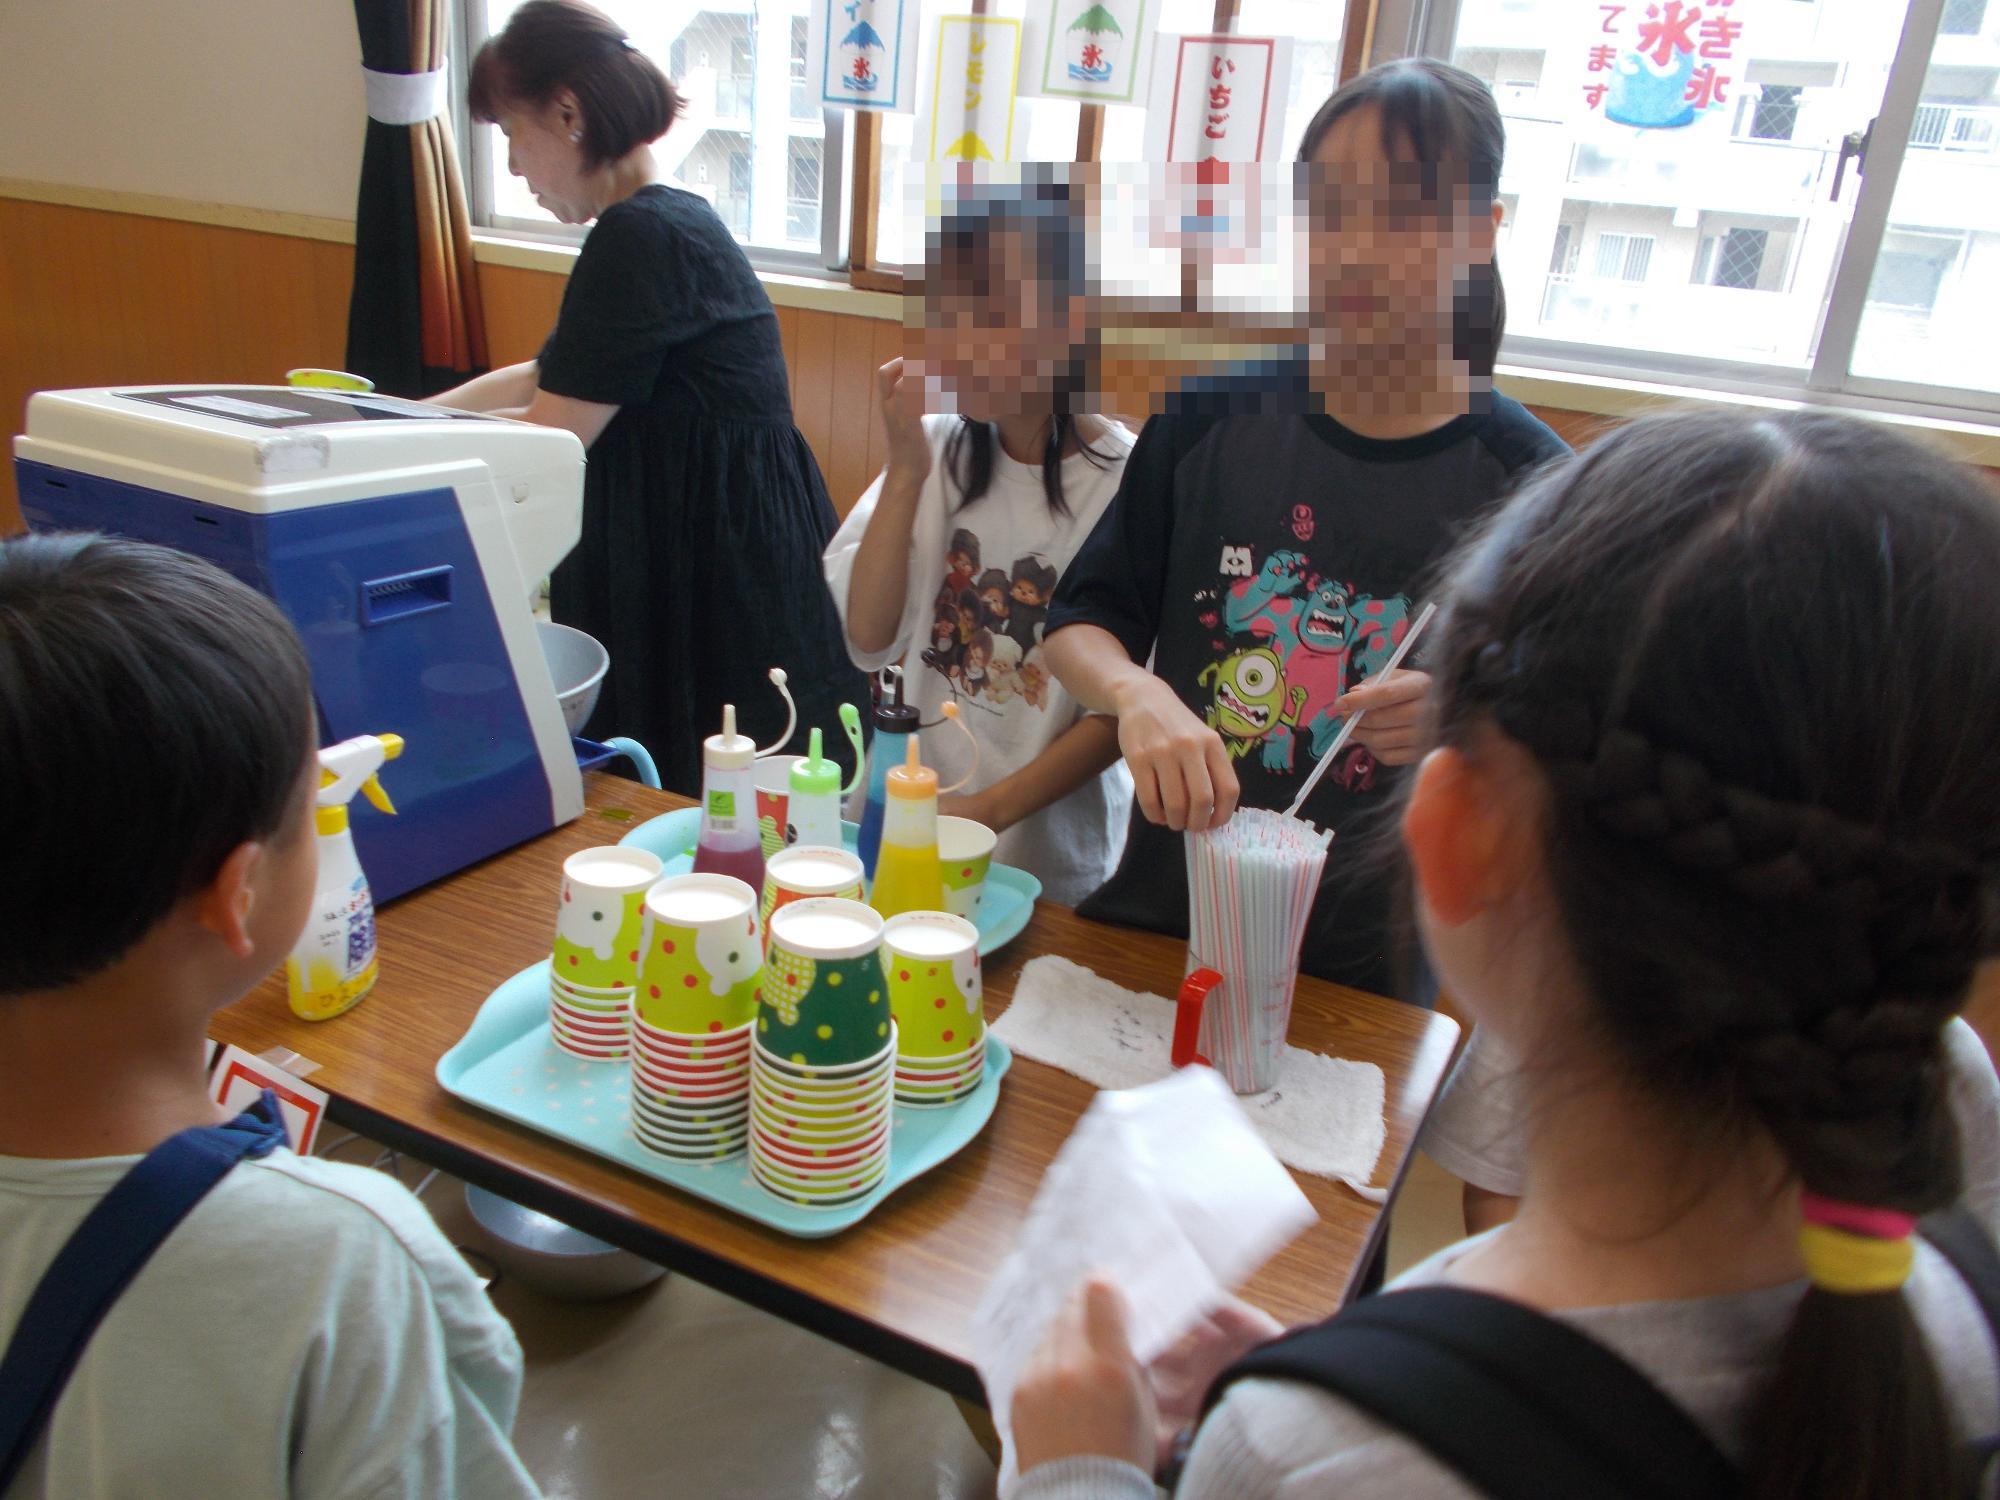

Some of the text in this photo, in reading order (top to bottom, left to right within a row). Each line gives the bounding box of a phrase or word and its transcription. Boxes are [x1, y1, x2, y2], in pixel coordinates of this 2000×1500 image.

[853, 56, 870, 79] 氷
[964, 31, 987, 110] レモン
[1081, 43, 1103, 69] 氷
[1582, 5, 1627, 110] てます
[1636, 0, 1702, 67] 氷
[1682, 0, 1743, 109] き氷
[1205, 55, 1236, 139] いちご
